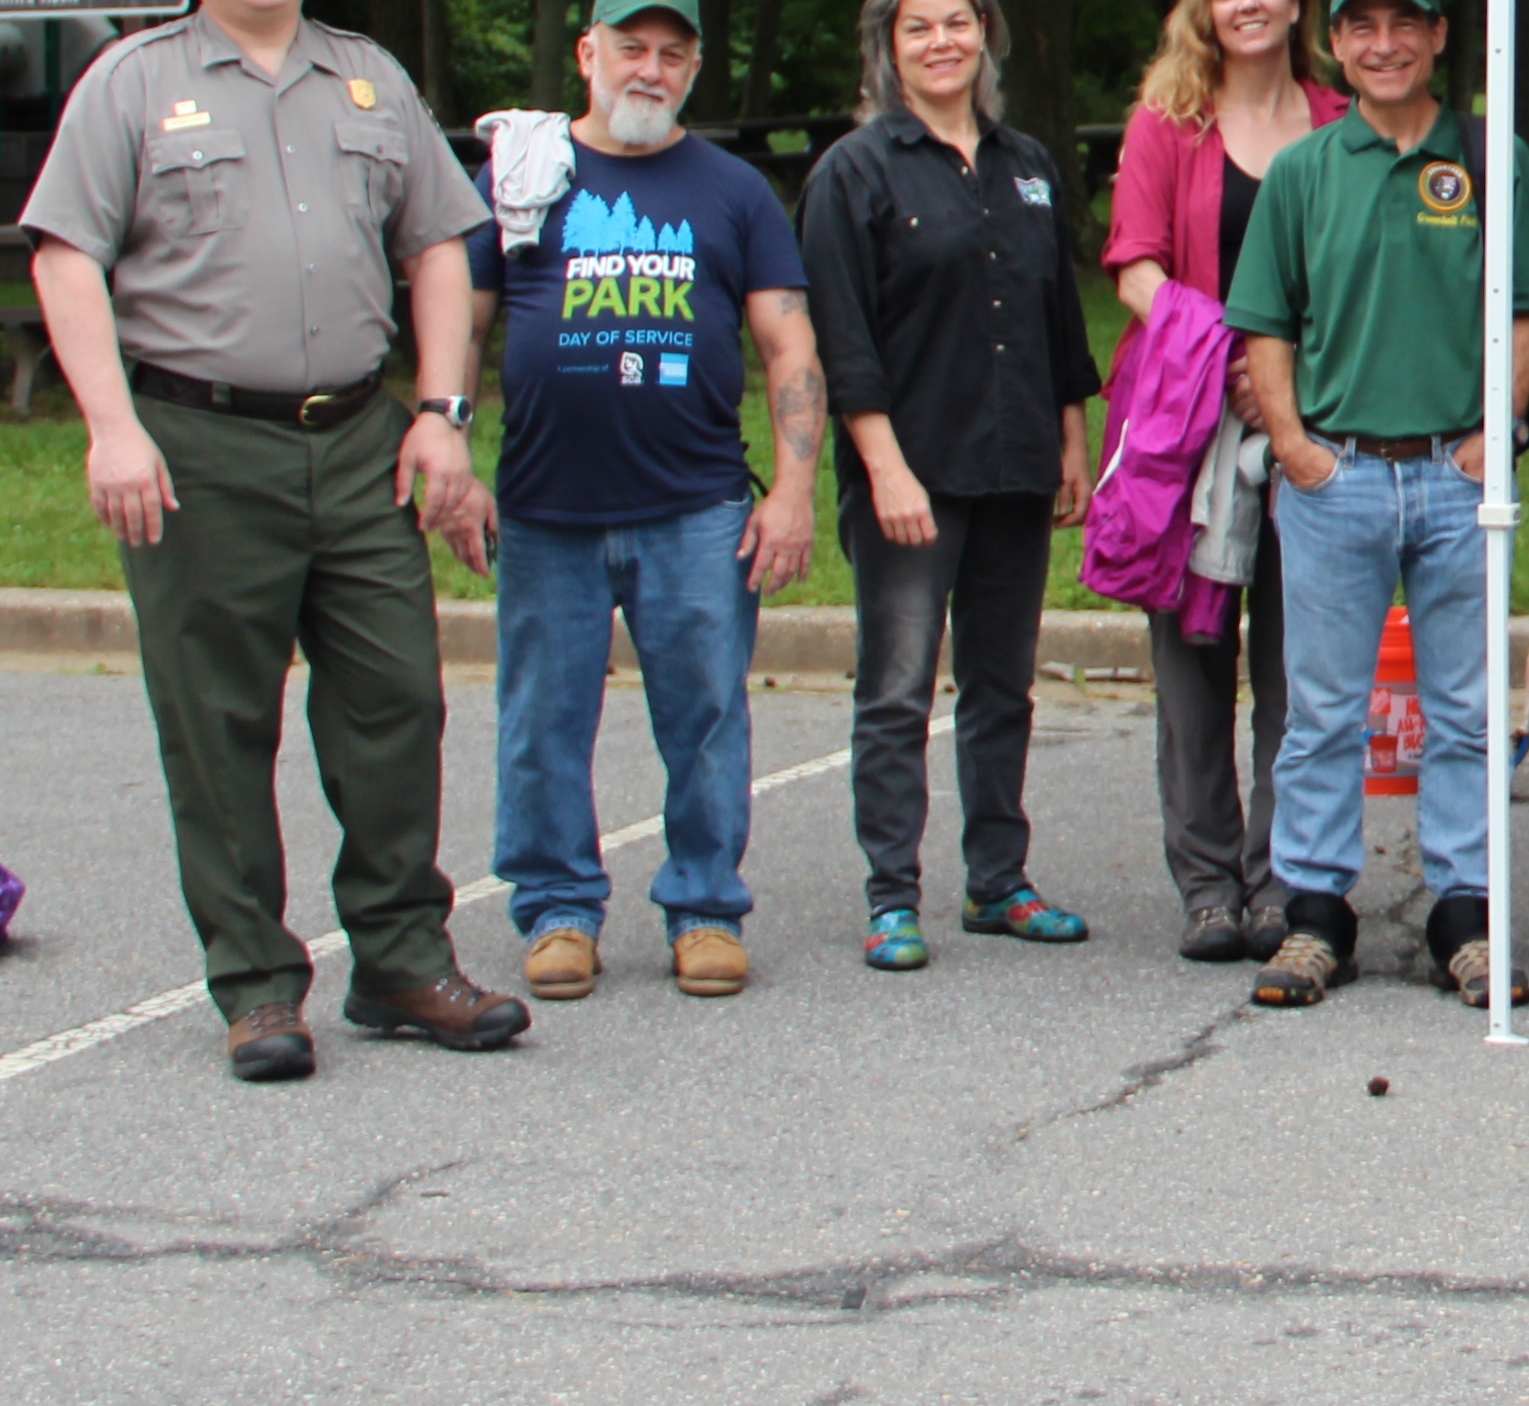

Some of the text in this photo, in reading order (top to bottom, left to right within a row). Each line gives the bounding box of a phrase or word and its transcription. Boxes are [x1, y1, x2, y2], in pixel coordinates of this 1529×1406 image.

[566, 254, 697, 281] FIND YOUR
[562, 276, 696, 322] PARK
[558, 328, 694, 347] DAY OF SERVICE
